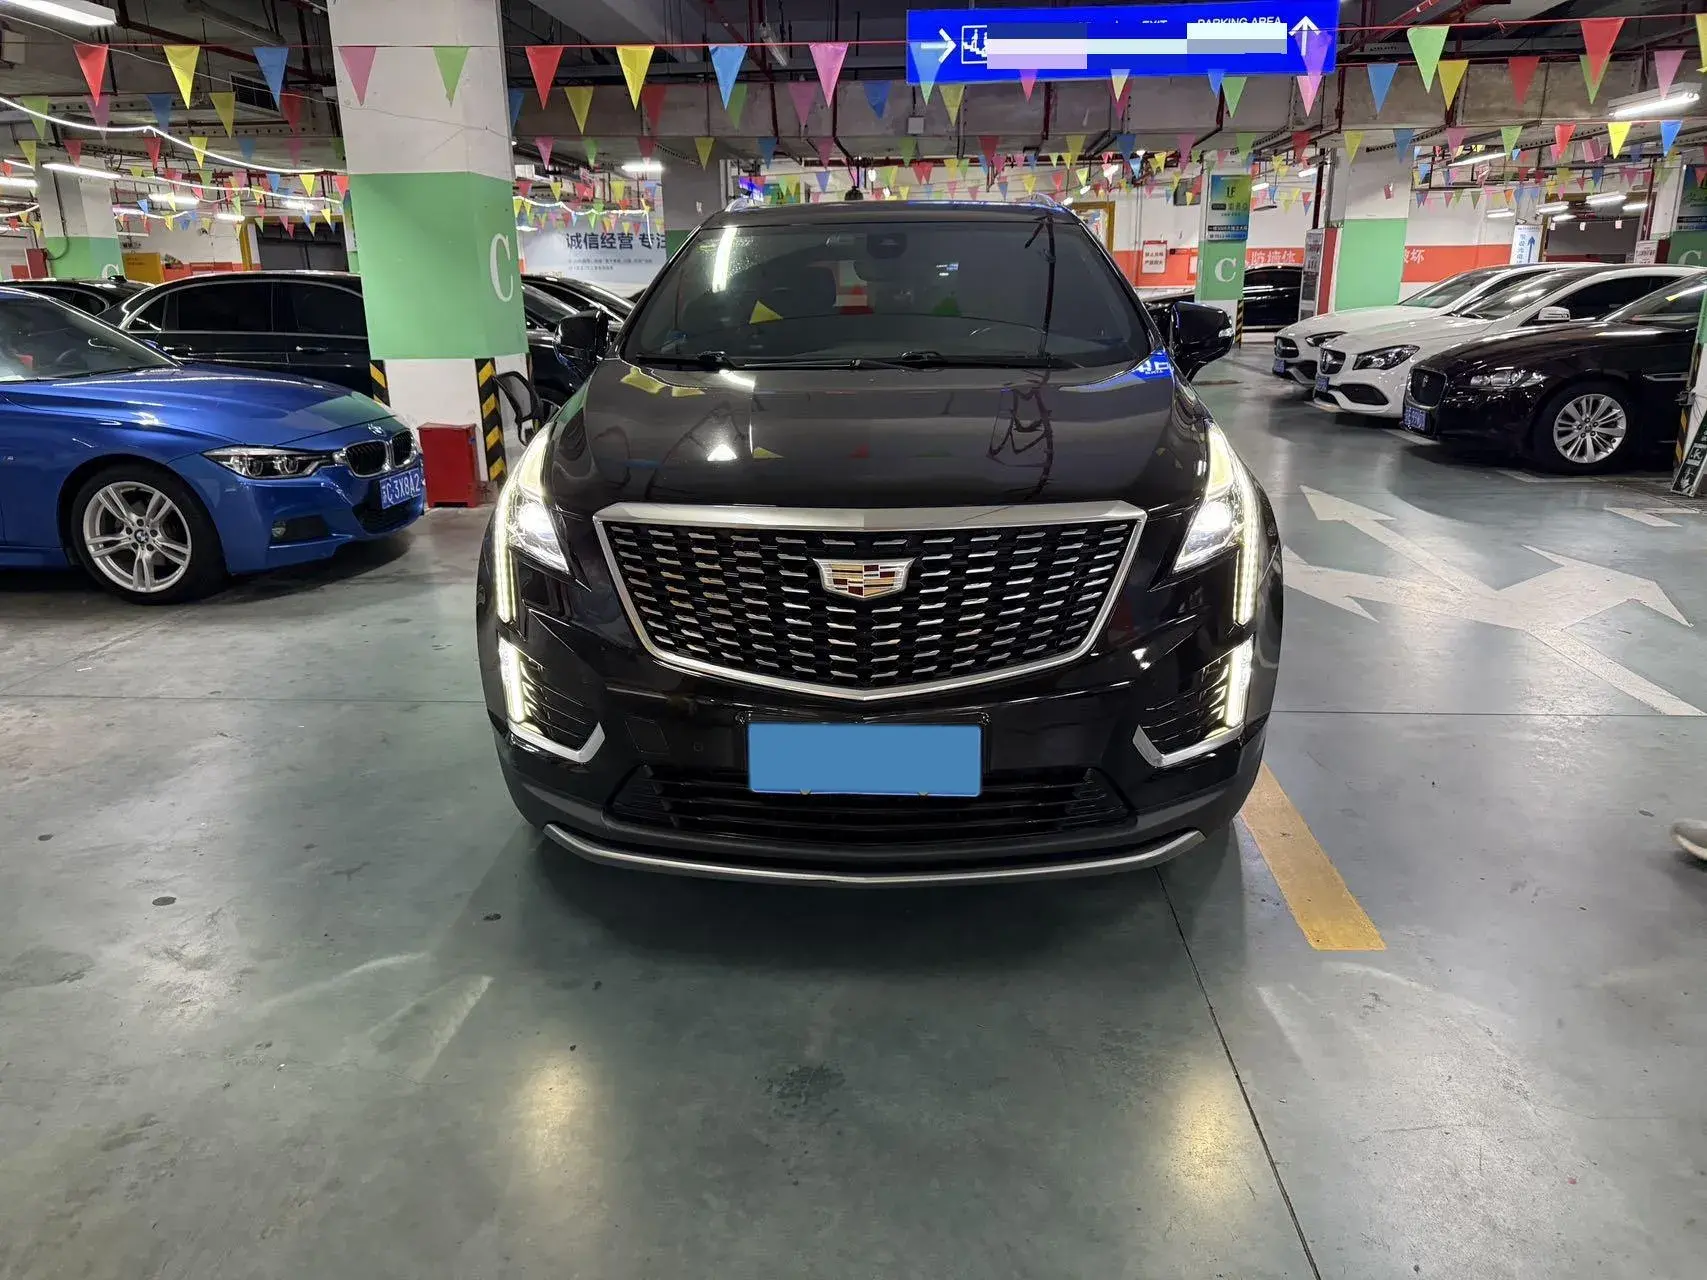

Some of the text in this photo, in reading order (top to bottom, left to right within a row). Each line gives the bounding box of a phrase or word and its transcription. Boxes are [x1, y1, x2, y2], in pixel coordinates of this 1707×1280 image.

[565, 232, 634, 250] 诚信经营
[489, 232, 514, 302] C
[1214, 257, 1237, 282] C
